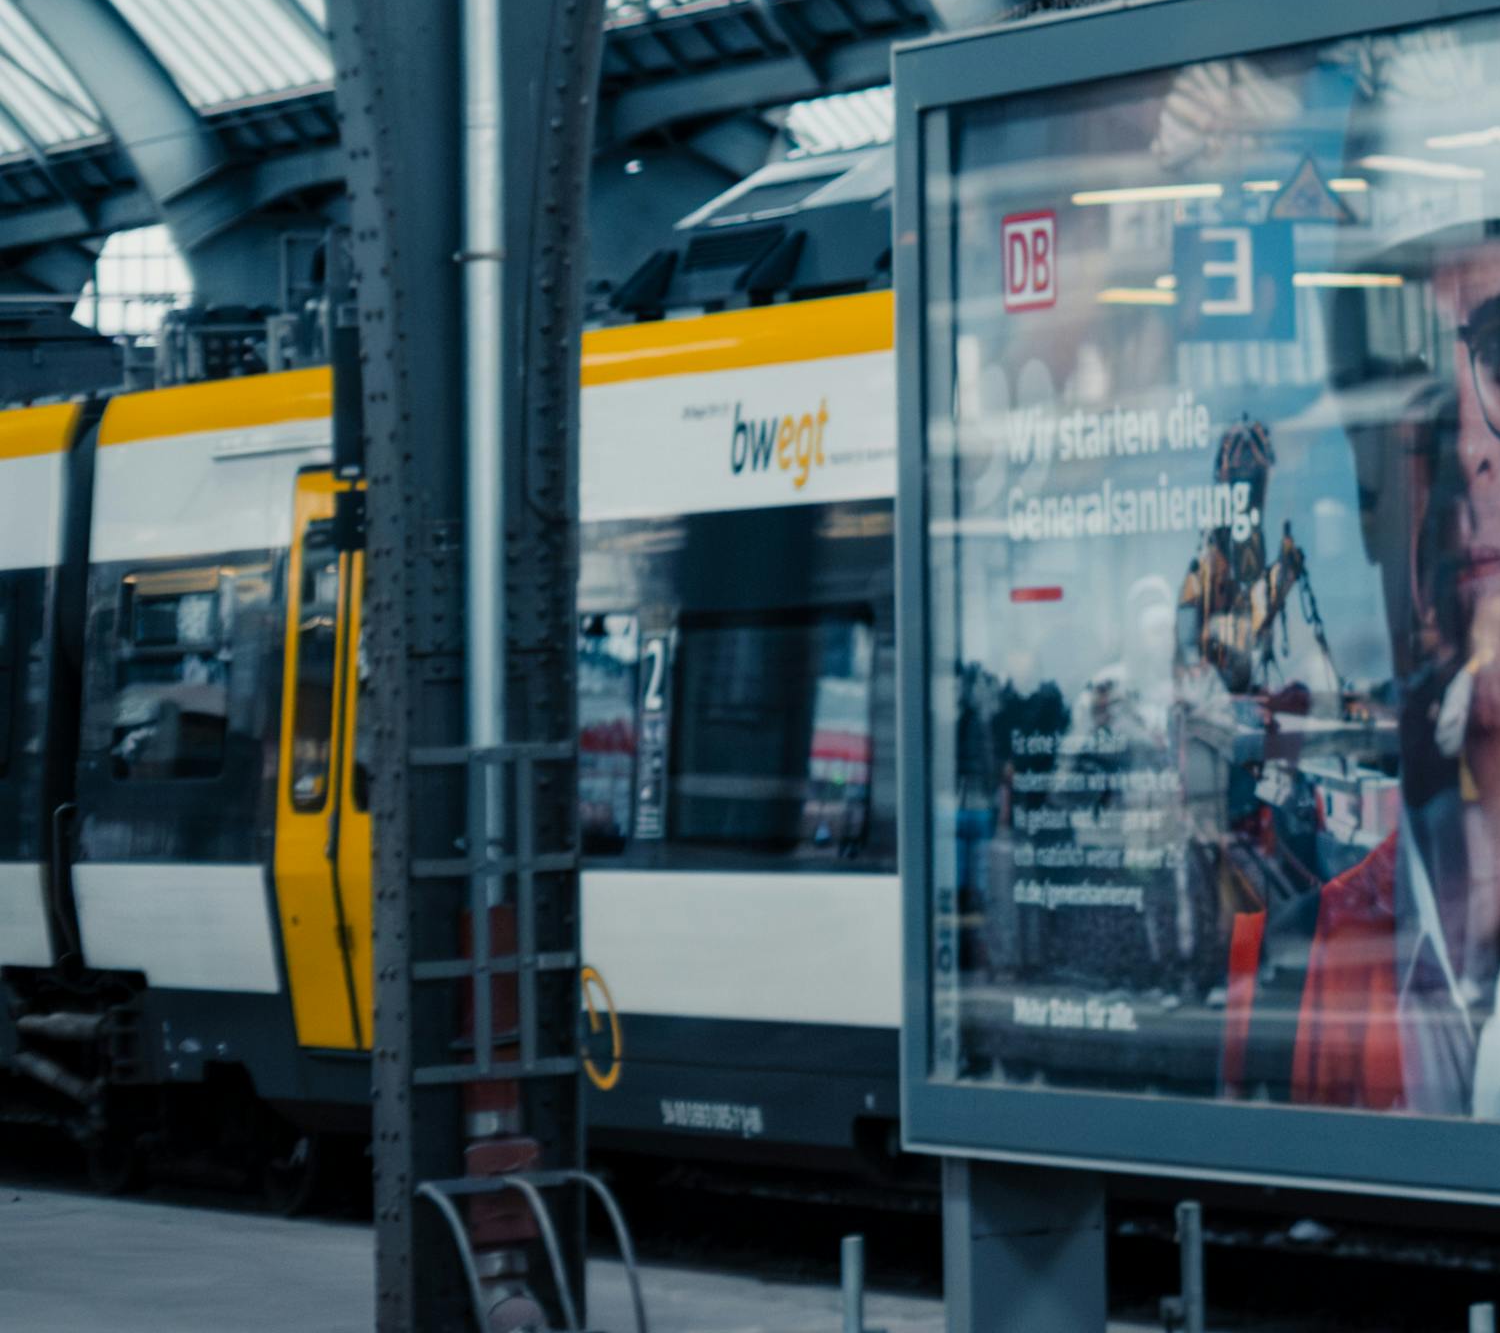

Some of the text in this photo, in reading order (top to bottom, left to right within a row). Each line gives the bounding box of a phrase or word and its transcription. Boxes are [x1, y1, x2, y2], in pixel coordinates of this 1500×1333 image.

[1008, 228, 1051, 296] DB
[731, 395, 830, 490] bwegt
[1007, 390, 1211, 464] Wir starten die
[1007, 472, 1261, 543] Generalsanierung.
[643, 640, 665, 711] 2
